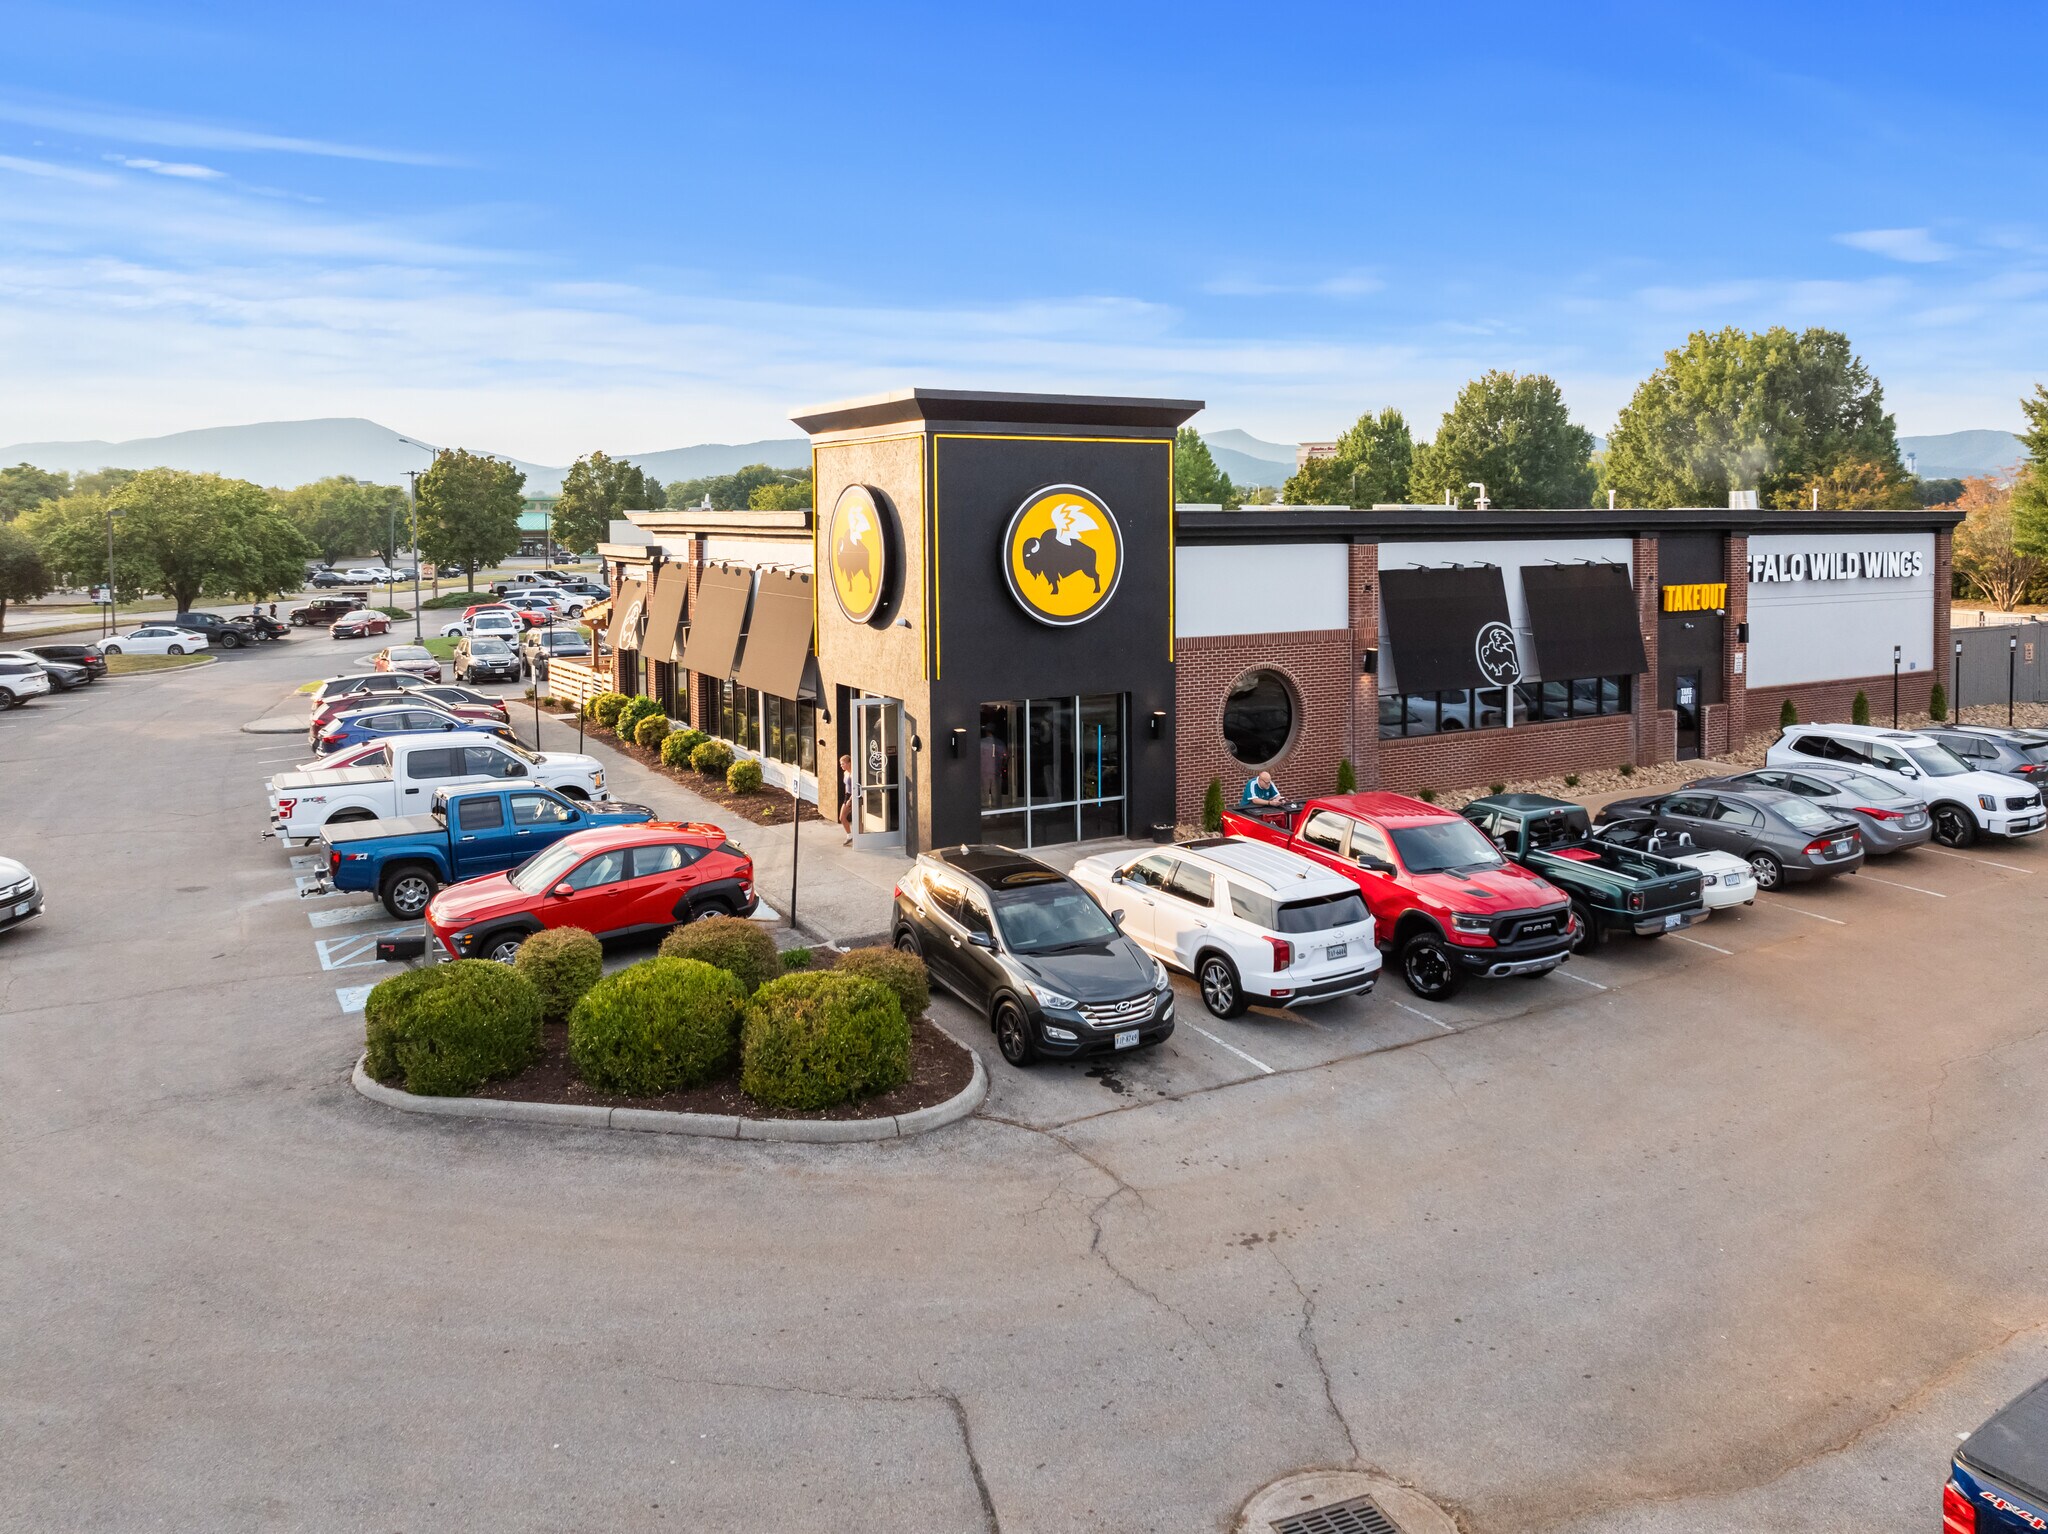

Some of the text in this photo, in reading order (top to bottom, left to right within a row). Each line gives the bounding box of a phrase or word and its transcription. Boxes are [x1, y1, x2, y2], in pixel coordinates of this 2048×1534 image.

[1809, 552, 1859, 581] WILD
[1863, 551, 1923, 579] WINGS
[1663, 583, 1727, 612] TAKEOUT
[1681, 687, 1692, 695] TAKE
[1681, 695, 1692, 704] OUT
[1523, 923, 1552, 932] RAM
